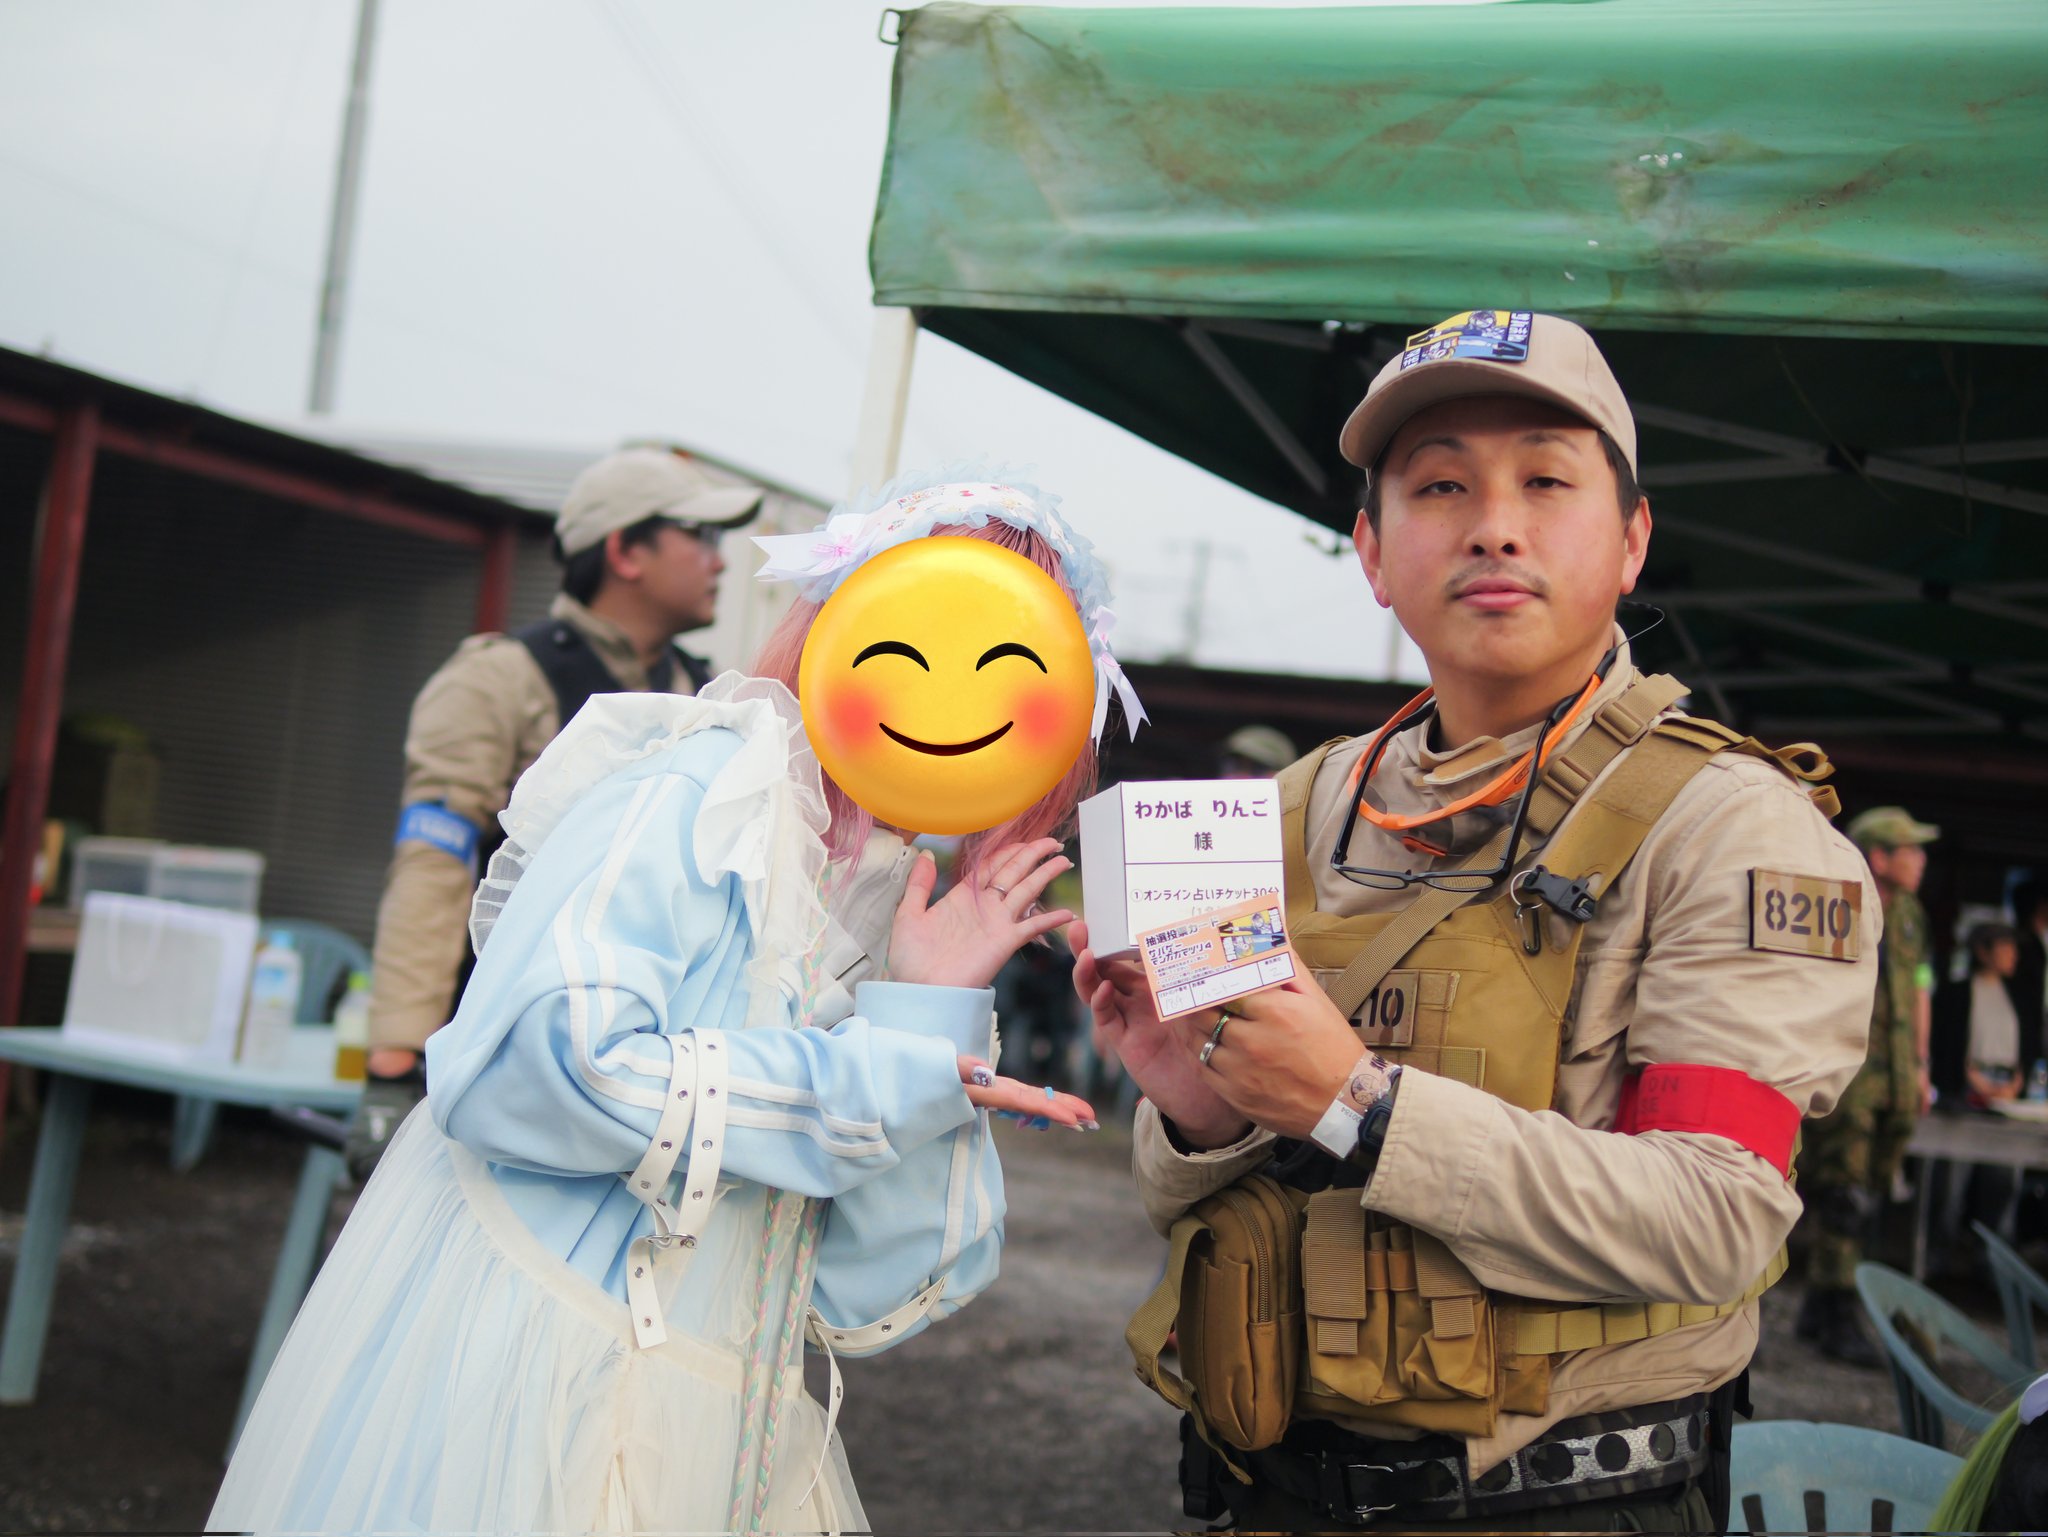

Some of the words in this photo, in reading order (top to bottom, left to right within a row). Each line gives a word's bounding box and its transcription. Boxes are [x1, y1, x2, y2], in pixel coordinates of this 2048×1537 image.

[1134, 800, 1193, 819] わかば
[1212, 799, 1269, 818] りんご
[1194, 832, 1213, 850] 様
[1765, 889, 1851, 939] 8210
[1350, 987, 1405, 1027] 10
